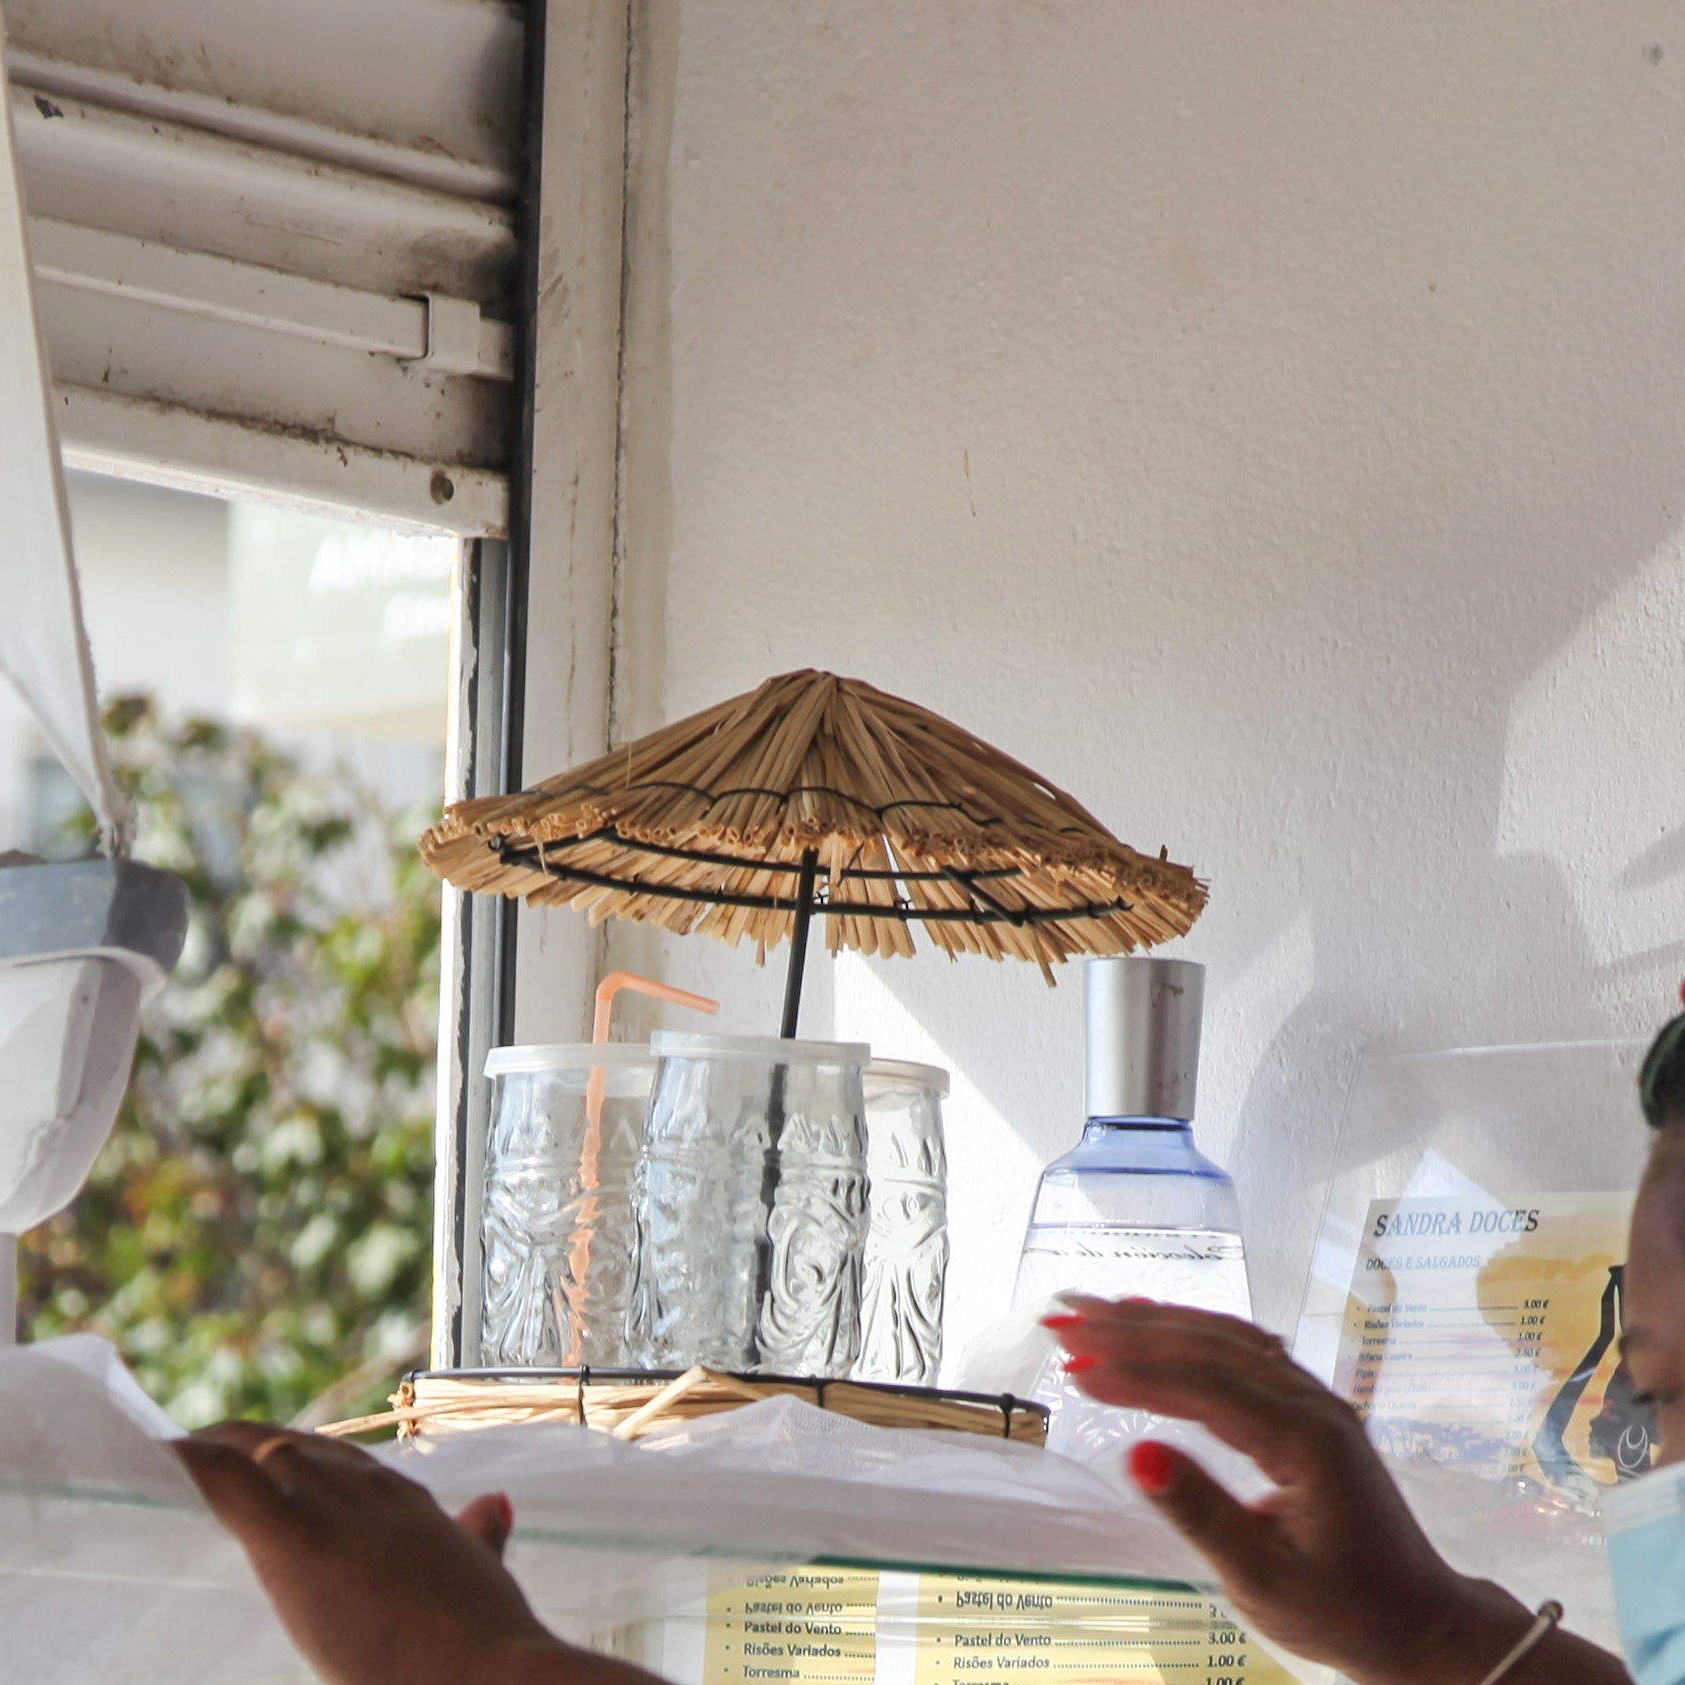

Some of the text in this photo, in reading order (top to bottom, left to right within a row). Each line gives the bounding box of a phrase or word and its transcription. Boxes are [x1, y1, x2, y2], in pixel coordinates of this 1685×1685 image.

[1373, 1209, 1541, 1237] SANDRA DOCES
[1366, 1255, 1480, 1270] DOCES E SALGADOS
[745, 1621, 841, 1636] Pastel do Vento
[954, 1631, 1247, 1647] Pastel do Vento 3.00 €
[744, 1643, 841, 1658] Risões Variados
[953, 1654, 1246, 1670] Risões Variados 1.00 €
[743, 1665, 800, 1679] Torresma
